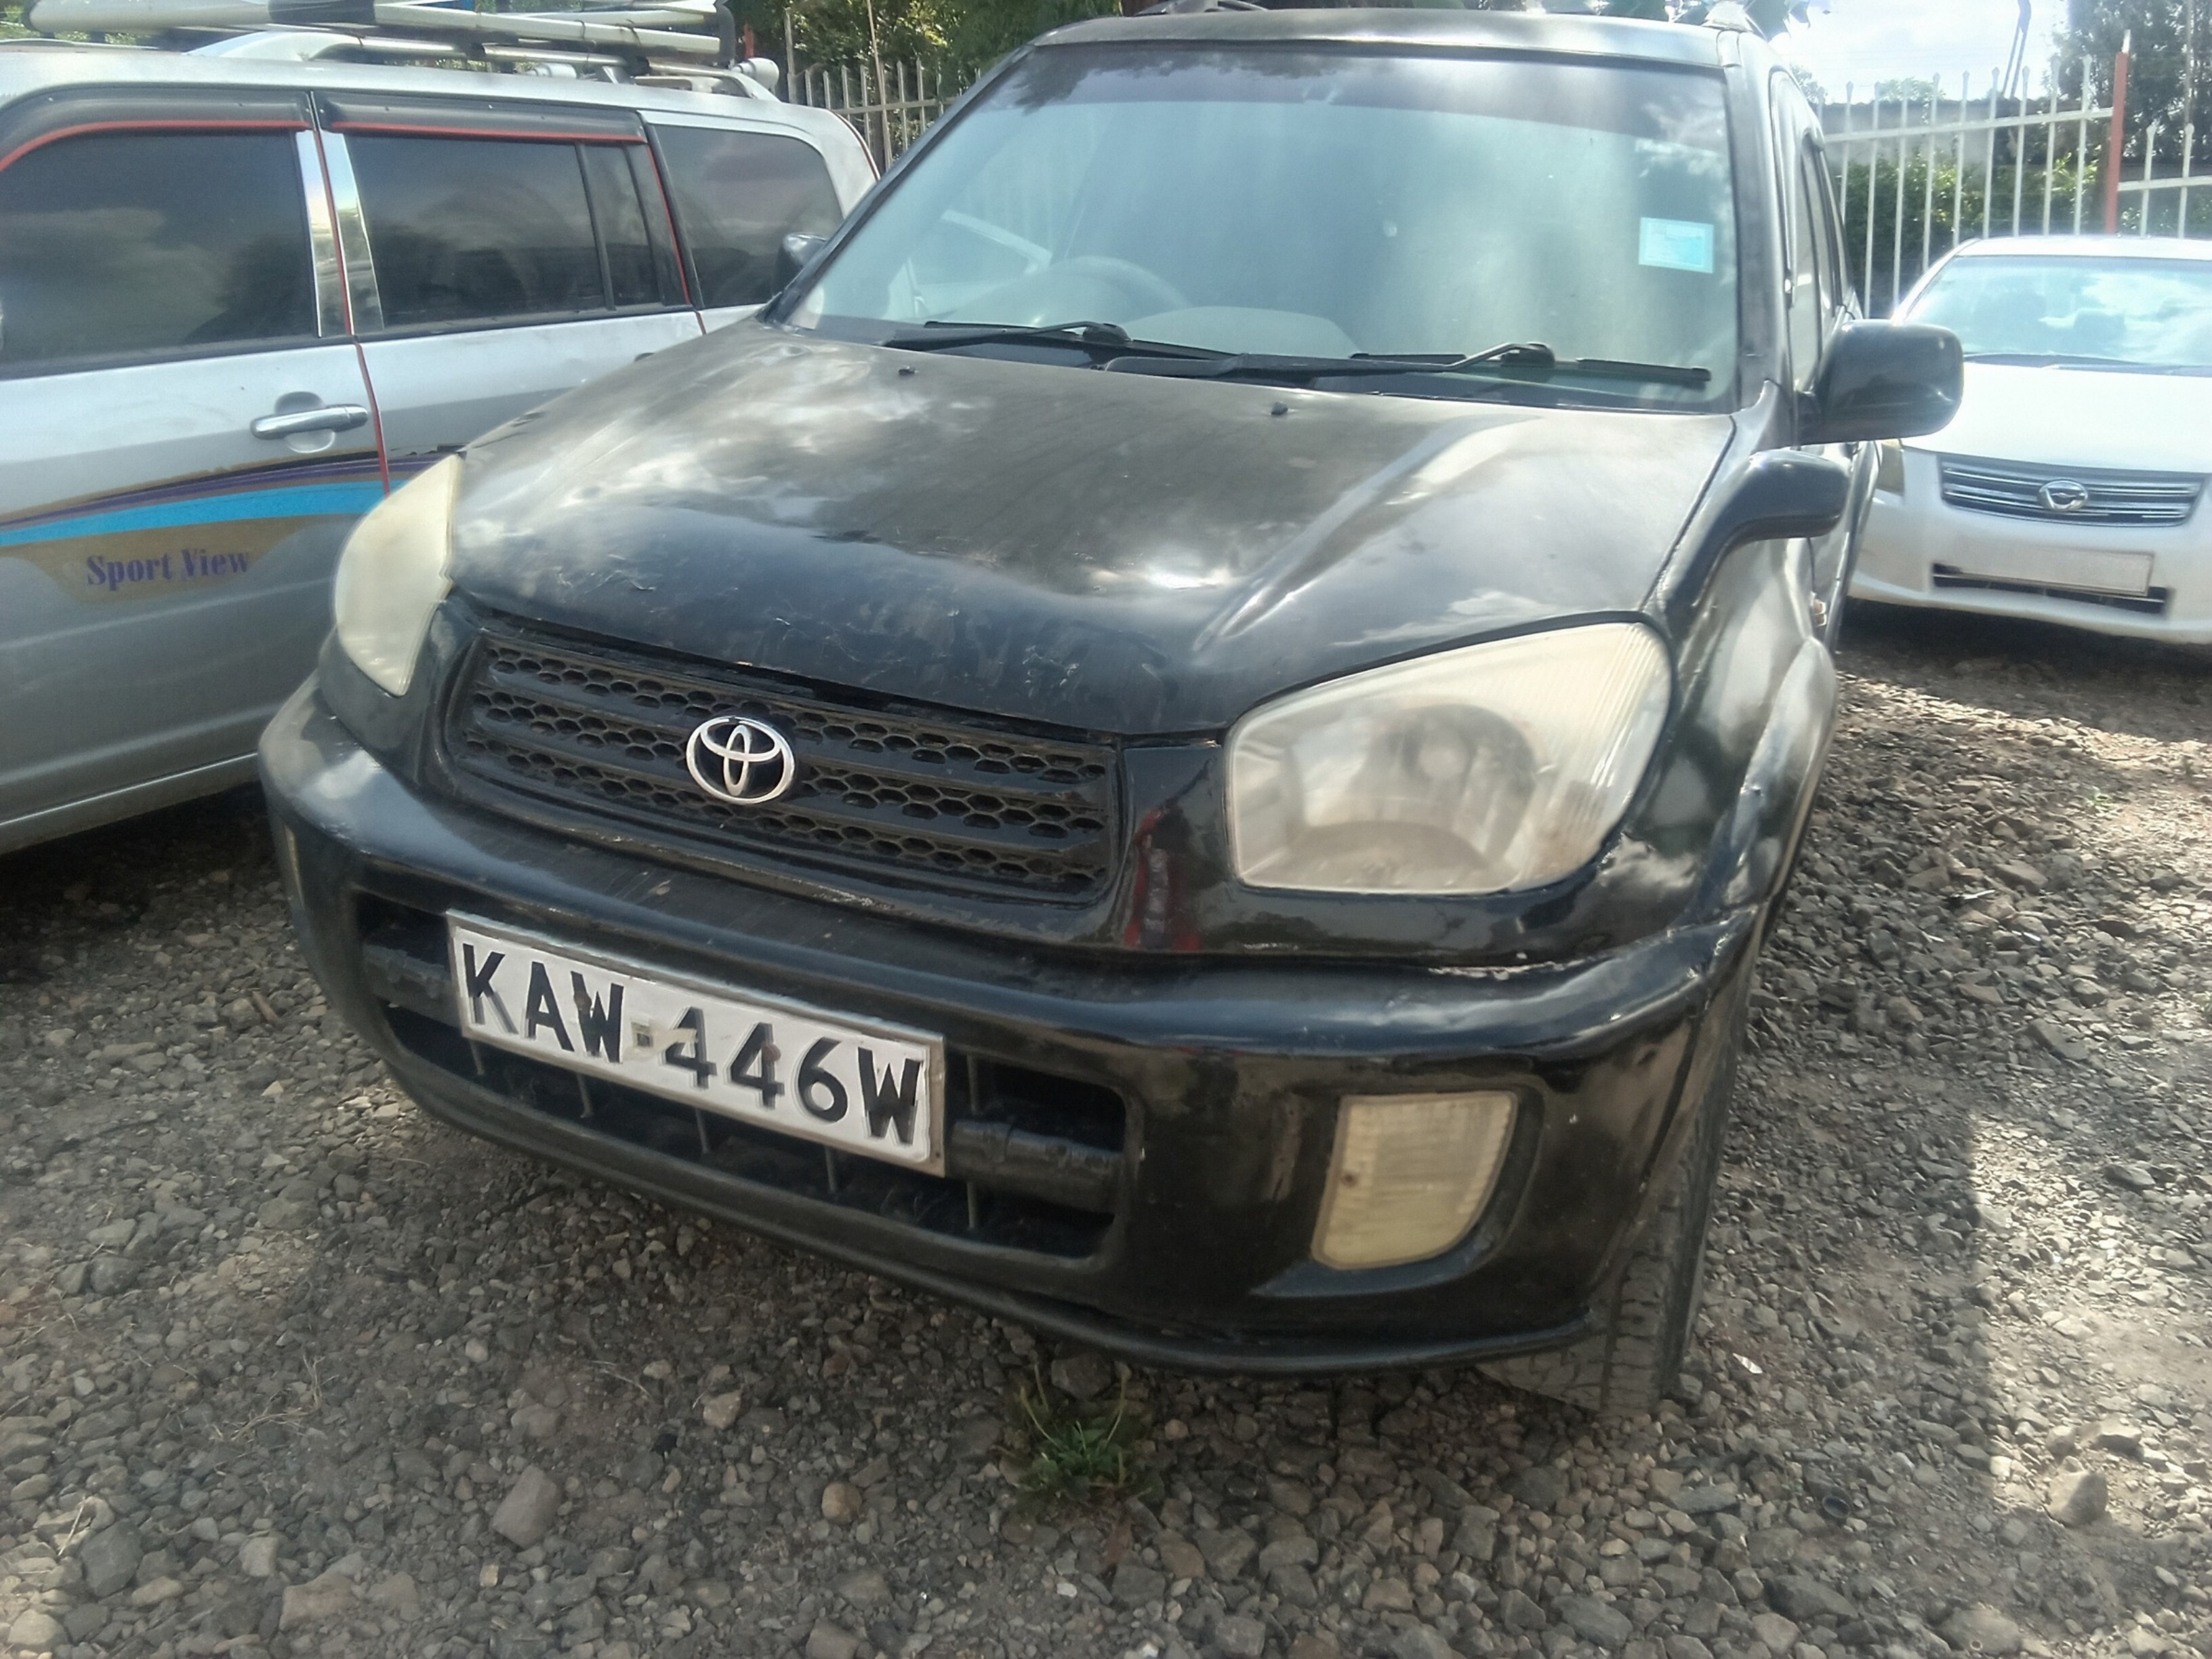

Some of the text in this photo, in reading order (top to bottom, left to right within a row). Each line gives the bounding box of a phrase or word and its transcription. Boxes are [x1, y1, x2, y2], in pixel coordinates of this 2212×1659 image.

[87, 548, 249, 591] Sport View
[462, 943, 924, 1146] KAW 446W
